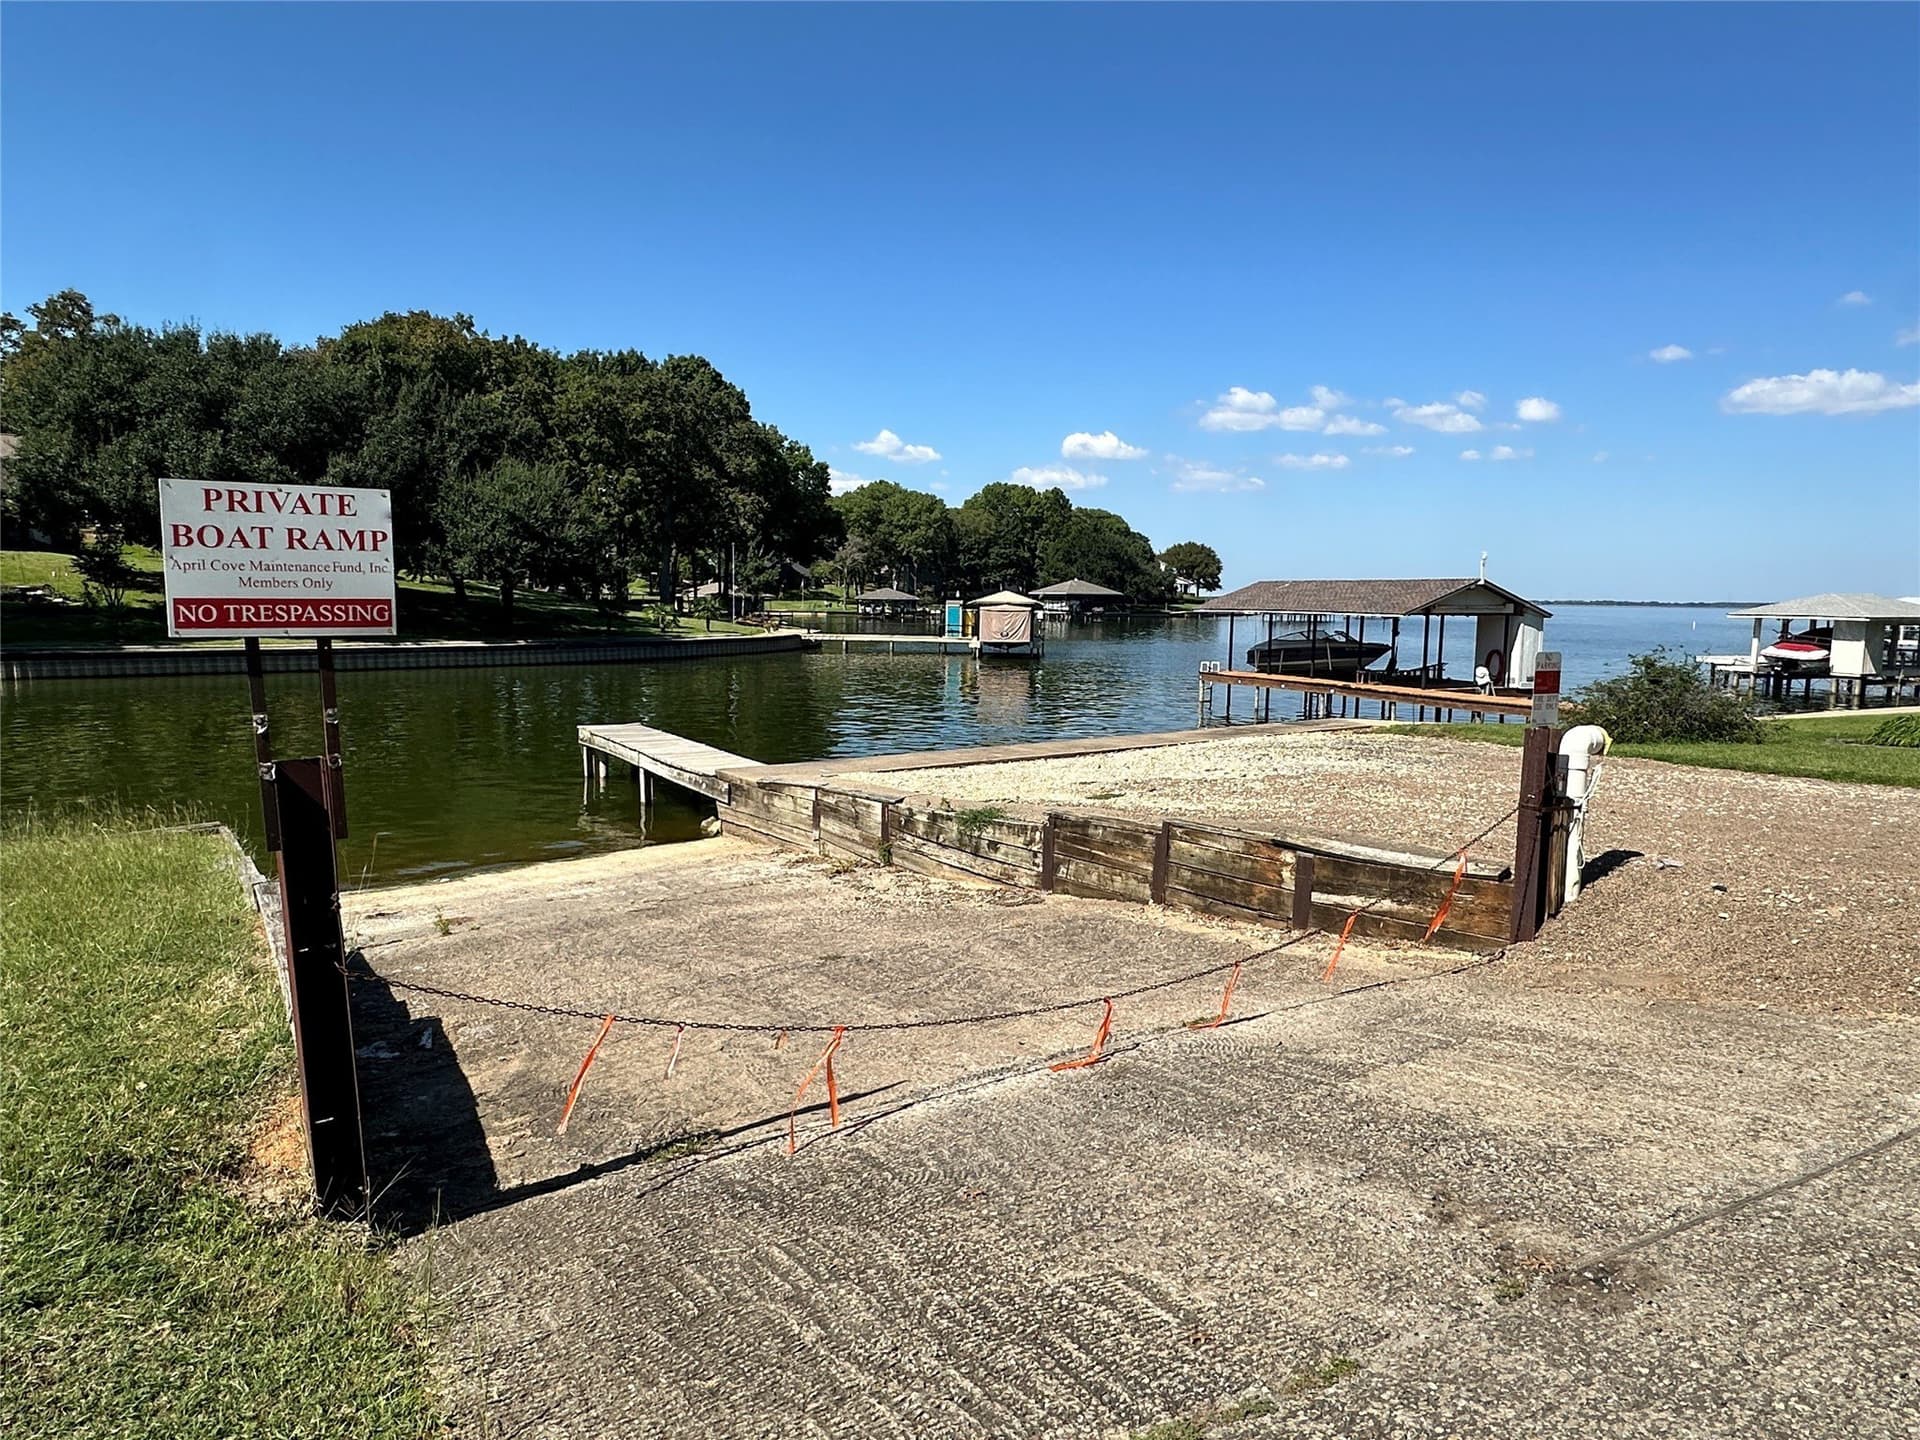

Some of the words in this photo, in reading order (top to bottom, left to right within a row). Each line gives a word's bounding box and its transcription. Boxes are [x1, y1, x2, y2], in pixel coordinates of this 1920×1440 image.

[201, 487, 358, 517] PRIVATE
[169, 523, 274, 550] BOAT
[285, 527, 388, 552] RAMP
[171, 560, 206, 572] April
[210, 560, 246, 572] Cove
[249, 560, 331, 573] Maintenance
[332, 561, 366, 575] Fund,
[238, 577, 299, 589] Members
[302, 578, 334, 591] Only
[176, 605, 218, 623] NO
[223, 604, 390, 623] TRESPASSING
